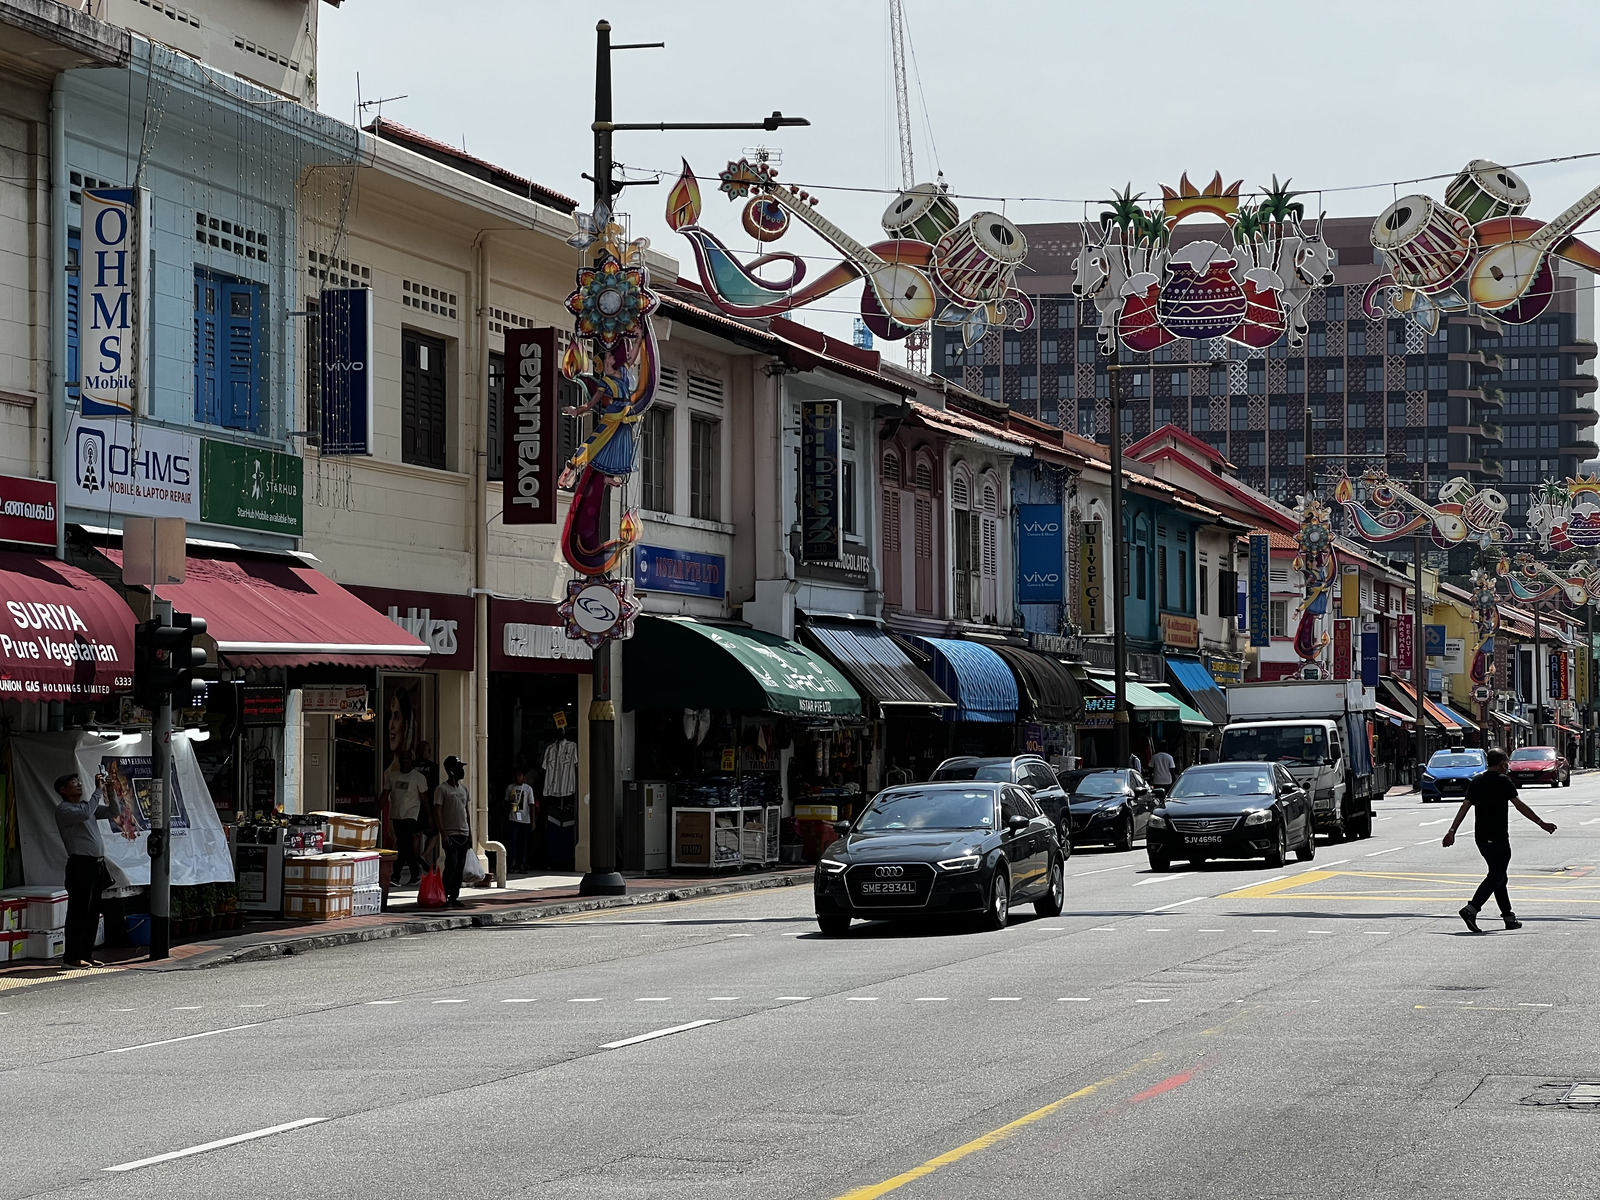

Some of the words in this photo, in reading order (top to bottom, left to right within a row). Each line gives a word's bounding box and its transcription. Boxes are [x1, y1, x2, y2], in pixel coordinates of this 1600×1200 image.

[91, 206, 131, 374] OHMS
[325, 360, 364, 371] vivo
[84, 375, 136, 391] Mobile
[109, 444, 190, 486] OHMS
[108, 481, 134, 496] MOBILE
[135, 485, 142, 496] &
[142, 486, 169, 501] LAPTOP
[170, 490, 192, 505] REPAIR
[265, 480, 297, 497] STARHUB
[237, 507, 255, 519] StarHub
[255, 510, 269, 521] Mobile
[1024, 521, 1058, 532] vivo
[1024, 571, 1058, 582] vivo
[6, 600, 89, 632] SURIYA
[0, 633, 40, 661] Pure
[37, 636, 119, 667] Vegetarian
[25, 680, 40, 693] GAS
[43, 683, 82, 693] HOLDINGS
[84, 684, 110, 694] LIMITED
[115, 676, 133, 686] 6333
[862, 883, 916, 894] SME2934L
